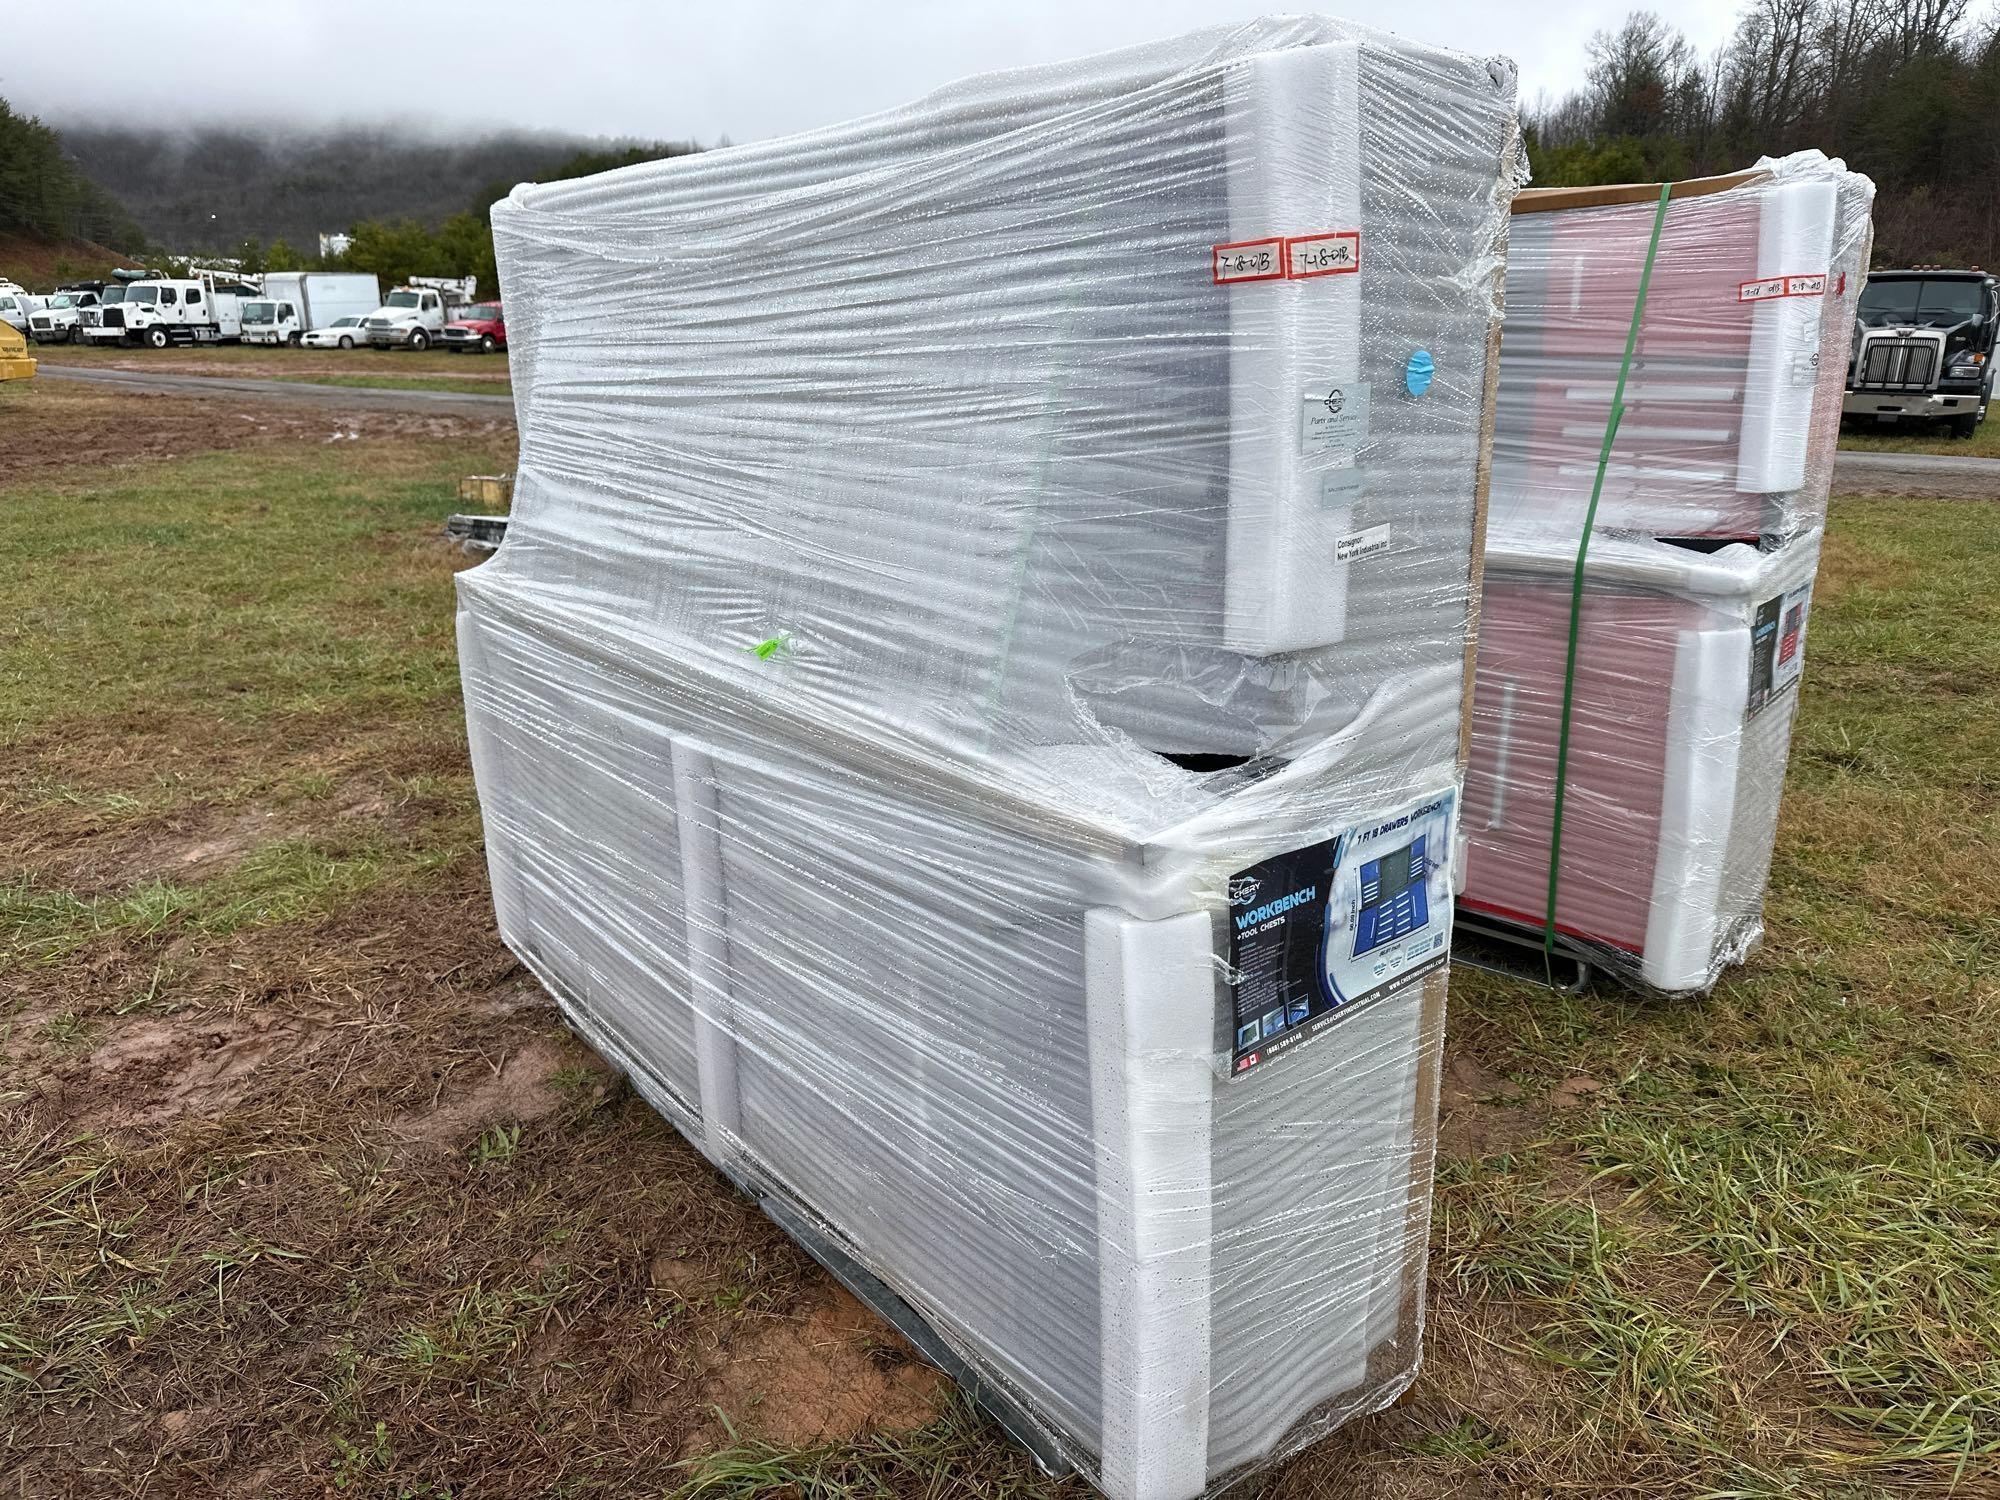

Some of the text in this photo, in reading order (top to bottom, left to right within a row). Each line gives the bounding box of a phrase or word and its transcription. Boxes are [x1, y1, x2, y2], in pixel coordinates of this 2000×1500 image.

[1337, 552, 1348, 560] New
[1349, 549, 1359, 558] York
[1363, 831, 1371, 843] FT
[1380, 816, 1409, 836] DRAWERS
[1410, 800, 1442, 822] WORKBENCH
[1235, 886, 1316, 930] WORKBENCH
[1260, 916, 1286, 932] CHESTS
